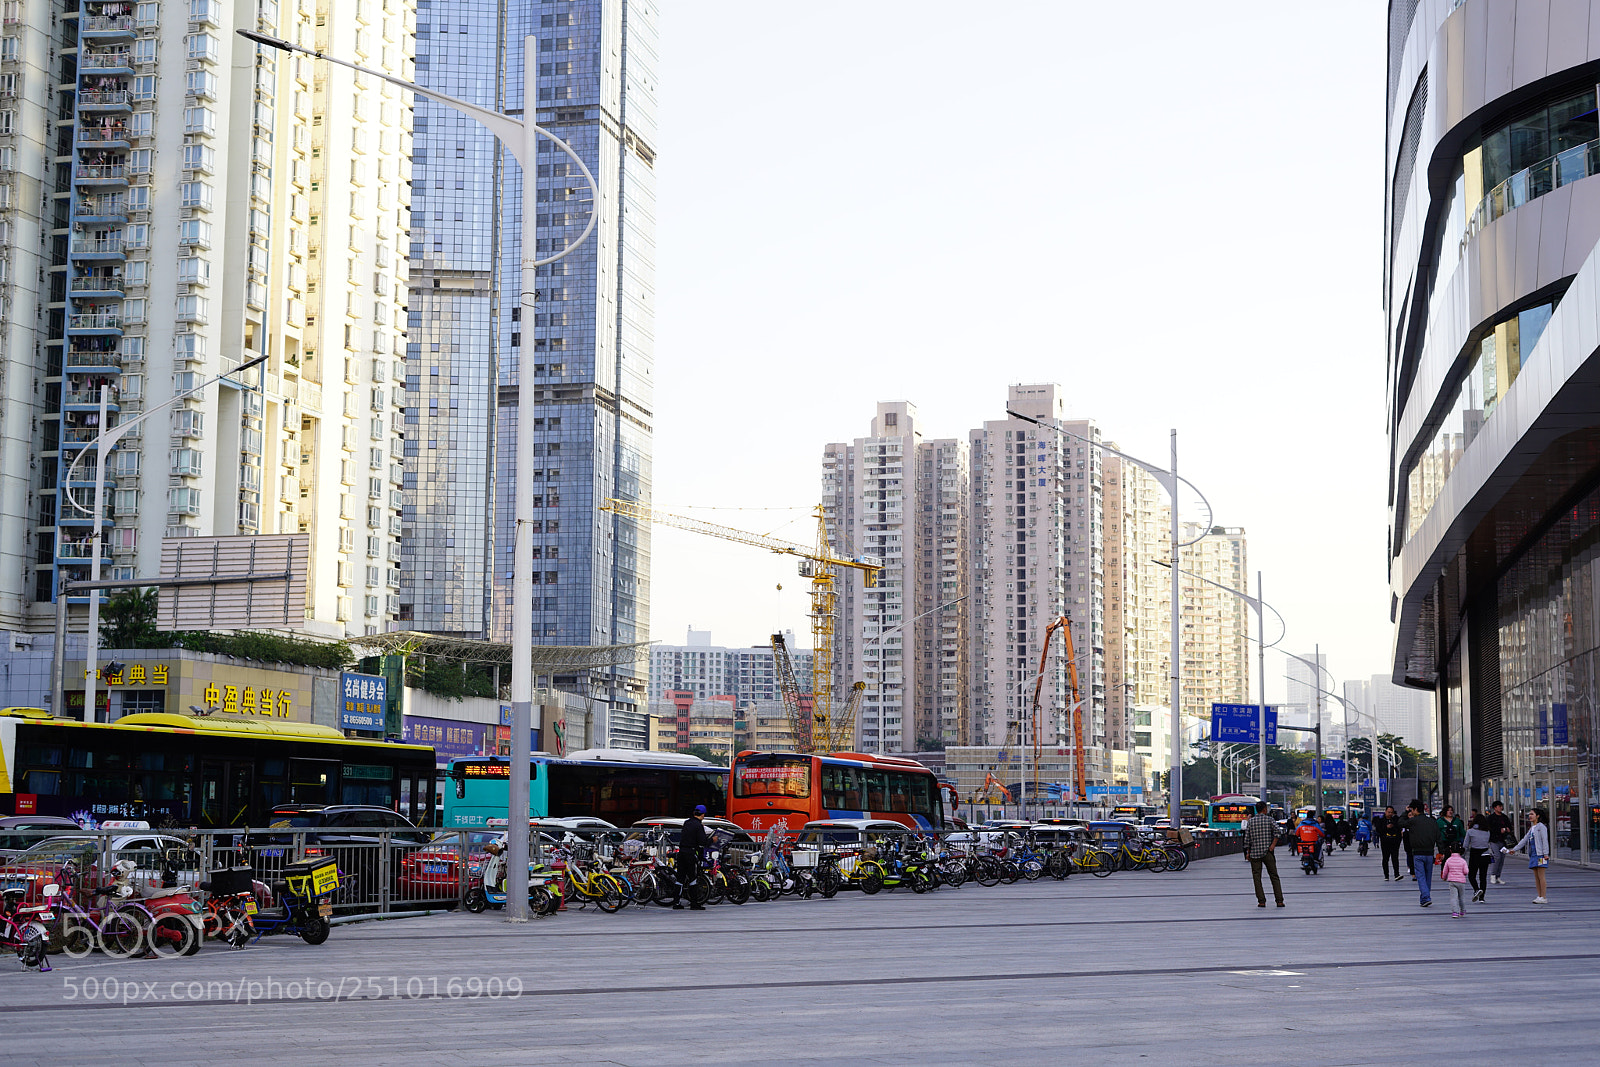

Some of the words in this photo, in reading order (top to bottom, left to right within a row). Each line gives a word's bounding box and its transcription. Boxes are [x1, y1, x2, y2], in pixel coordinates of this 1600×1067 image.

[204, 682, 292, 718] 中盈典当行
[344, 677, 385, 701] 名尚健身会
[454, 815, 484, 825] 干线巴士
